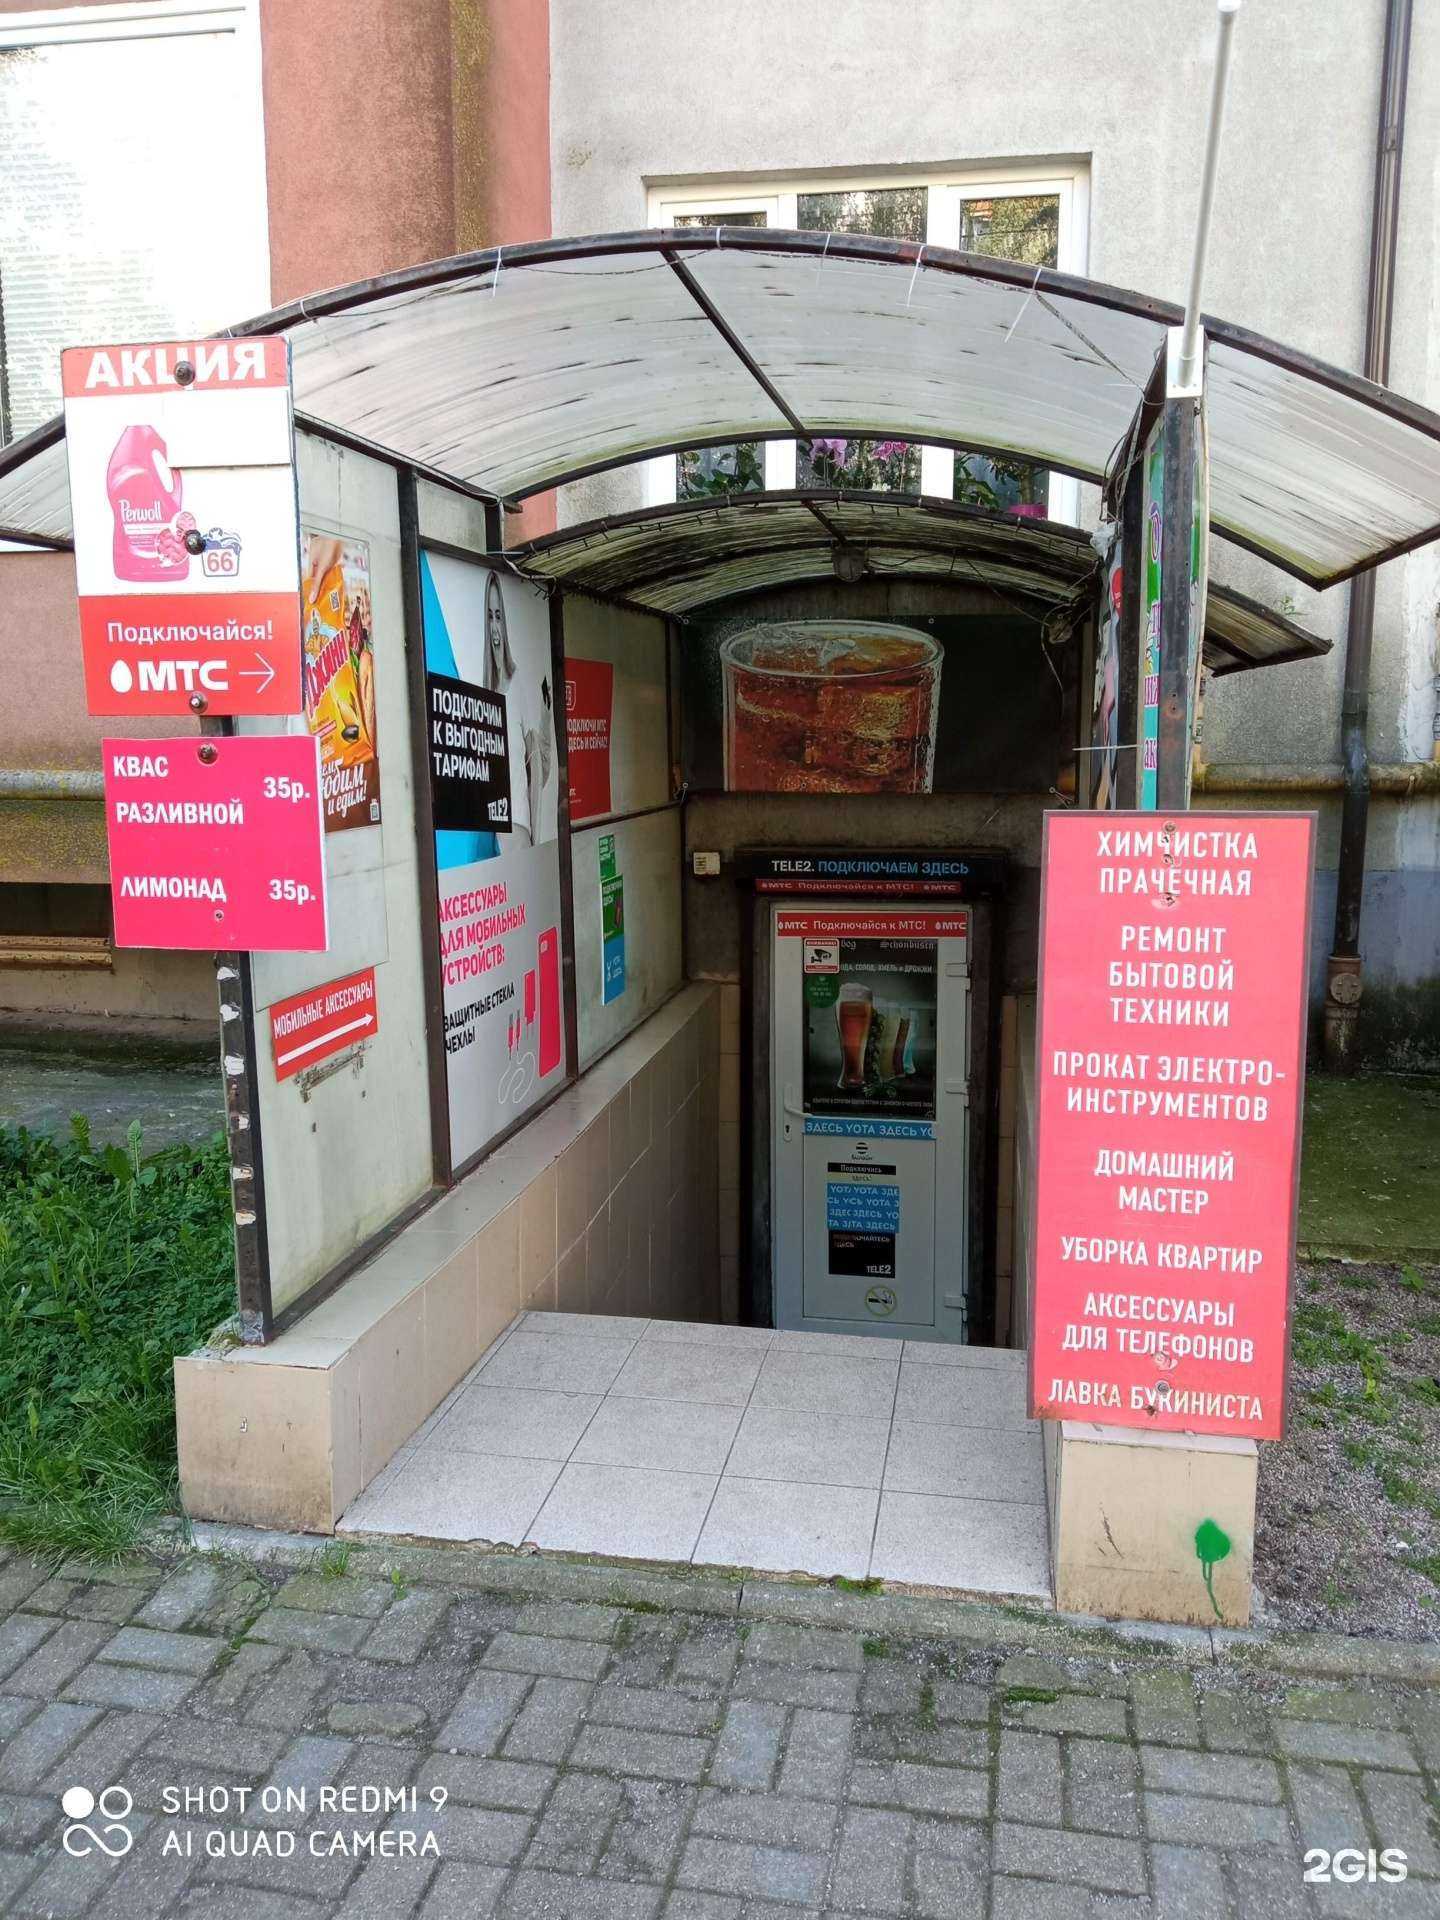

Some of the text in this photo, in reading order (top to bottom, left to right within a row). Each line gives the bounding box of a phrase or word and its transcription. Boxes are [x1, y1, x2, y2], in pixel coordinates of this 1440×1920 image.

[84, 342, 267, 390] АКЦИЯ
[118, 499, 162, 523] Perwoll
[207, 551, 233, 573] 66
[107, 621, 274, 647] Подключайся!
[137, 660, 230, 691] МТС
[433, 687, 503, 728] ПОДКЛЮЧИМ
[433, 720, 505, 757] К ВЫГОДНЫМ
[567, 719, 596, 734] ОДКЛЮЧИ
[568, 737, 584, 752] ДЕСЬ
[113, 755, 311, 804] КВАС 35р.
[433, 752, 490, 782] ТАРИФАМ
[116, 798, 244, 825] РАЗЛИВНОЙ
[487, 798, 509, 822] TELE2
[1097, 831, 1258, 859] ХИМЧИСТКА
[818, 860, 918, 875] ПОДКЛЮЧАЕМ
[921, 861, 969, 876] ЗДЕСЬ
[1100, 867, 1252, 896] ПРАЧЕЧНАЯ
[120, 877, 317, 905] ЛИМОНАД 35р.
[798, 881, 873, 891] Подключайся
[438, 881, 507, 923] АКСЕССУАРЫ
[440, 904, 526, 959] ДЛЯ МОБИЛЬНЫХ
[784, 920, 967, 932] МТС Подключайся к МТС! МТС
[1121, 925, 1227, 954] РЕМОНТ
[1109, 959, 1234, 991] БЫТОВОЙ
[273, 980, 374, 1040] МОБИЛЬНЫЕ АКСЕССУАРЫ
[443, 981, 515, 1032] ЗАЩИТНЫЕ СТЕКЛА
[1110, 997, 1230, 1027] ТЕХНИКИ
[445, 1026, 476, 1054] ЧЕХЛЫ
[1053, 1050, 1286, 1086] ПРОКАТ ЭЛЕКТРО-
[1067, 1087, 1268, 1121] ИНСТРУМЕНТОВ
[806, 1122, 843, 1133] ЗДЕСЬ
[846, 1123, 875, 1134] YOTA
[879, 1125, 918, 1136] ЗДЕСЬ
[1094, 1149, 1234, 1181] ДОМАШНИЙ
[1119, 1186, 1209, 1215] МАСТЕР
[866, 1264, 891, 1274] TELE2
[1061, 1236, 1263, 1274] УБОРКА КВАРТИР
[1083, 1292, 1235, 1328] АКСЕССУАРЫ
[1062, 1324, 1254, 1363] ДЛЯ ТЕЛЕФОНОВ
[1048, 1379, 1263, 1421] ЛАВКА БУКИНИСТА
